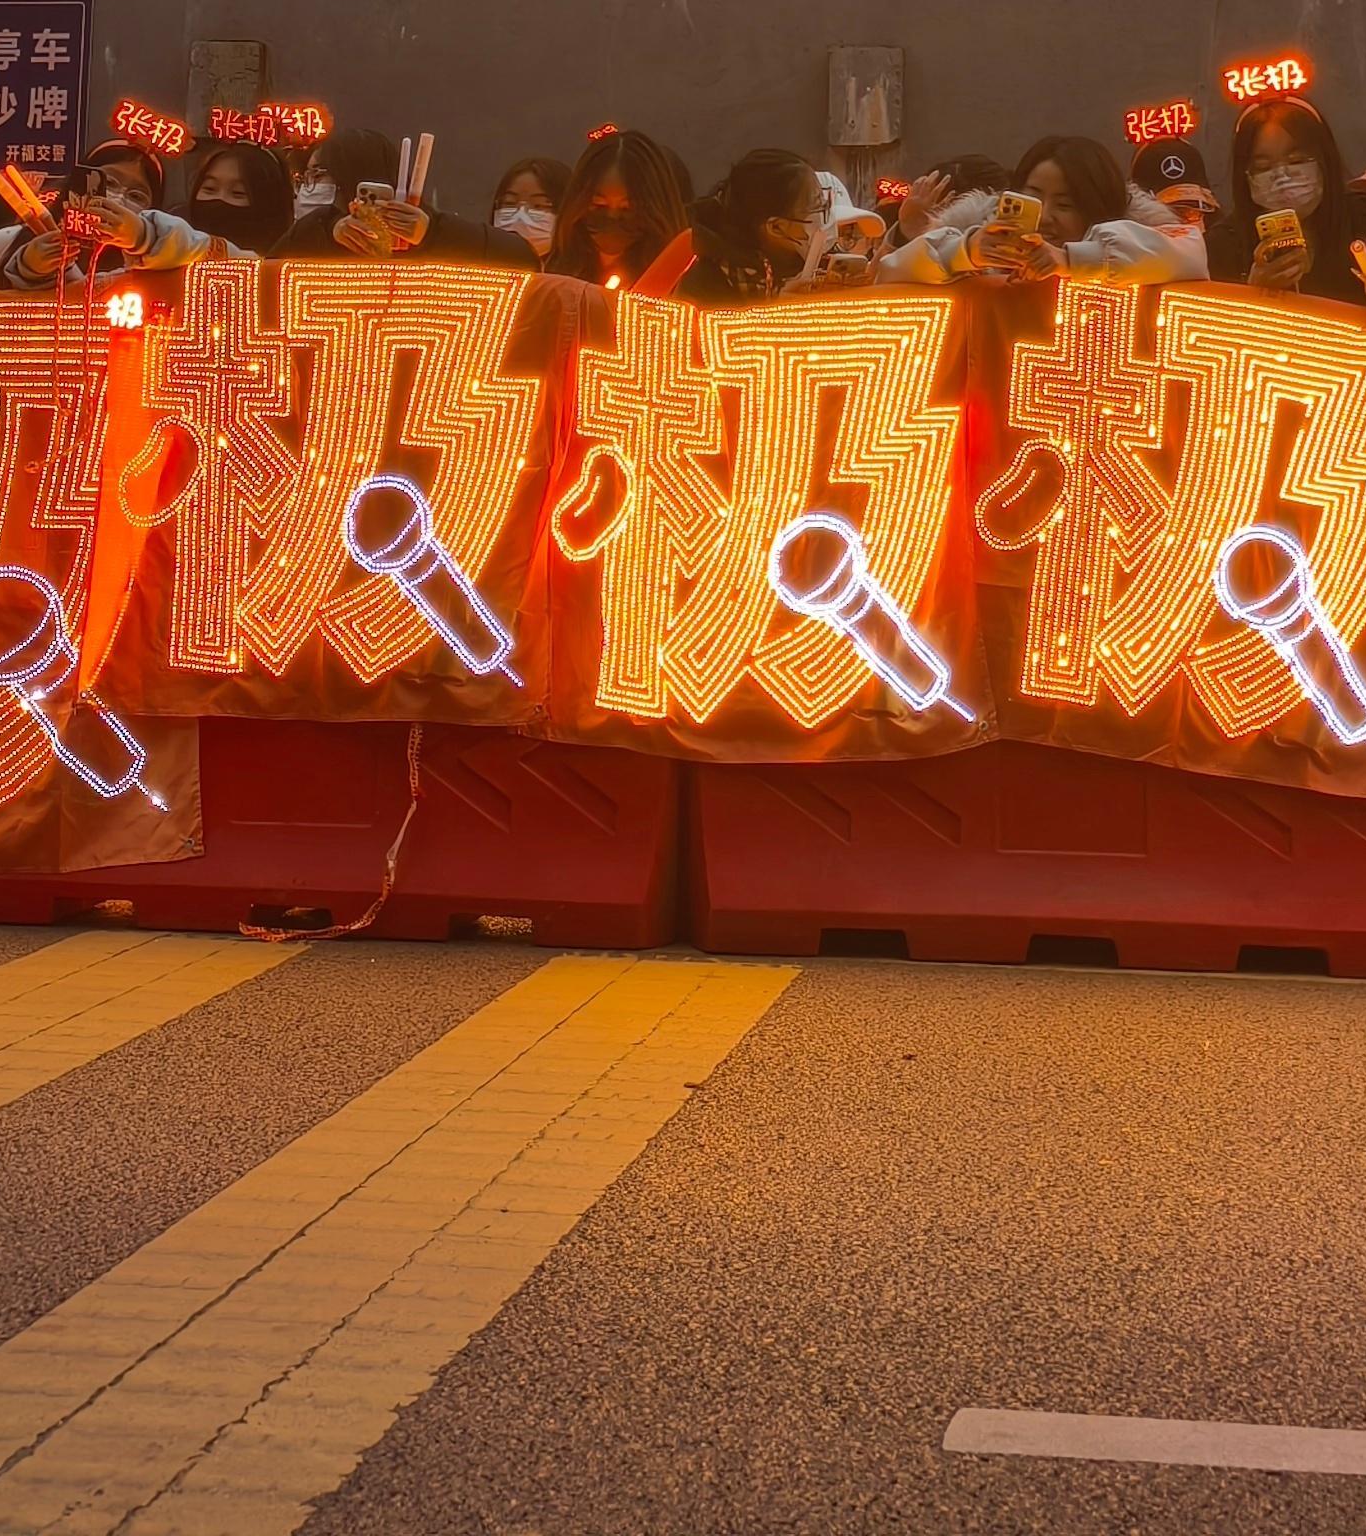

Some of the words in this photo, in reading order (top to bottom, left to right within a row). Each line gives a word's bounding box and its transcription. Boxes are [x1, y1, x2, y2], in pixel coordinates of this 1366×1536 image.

[1224, 59, 1308, 100] 张极
[116, 101, 185, 154] 张极
[211, 107, 278, 145] 张极
[1127, 103, 1194, 143] 张极
[119, 259, 541, 684] 极
[552, 291, 965, 730] 极
